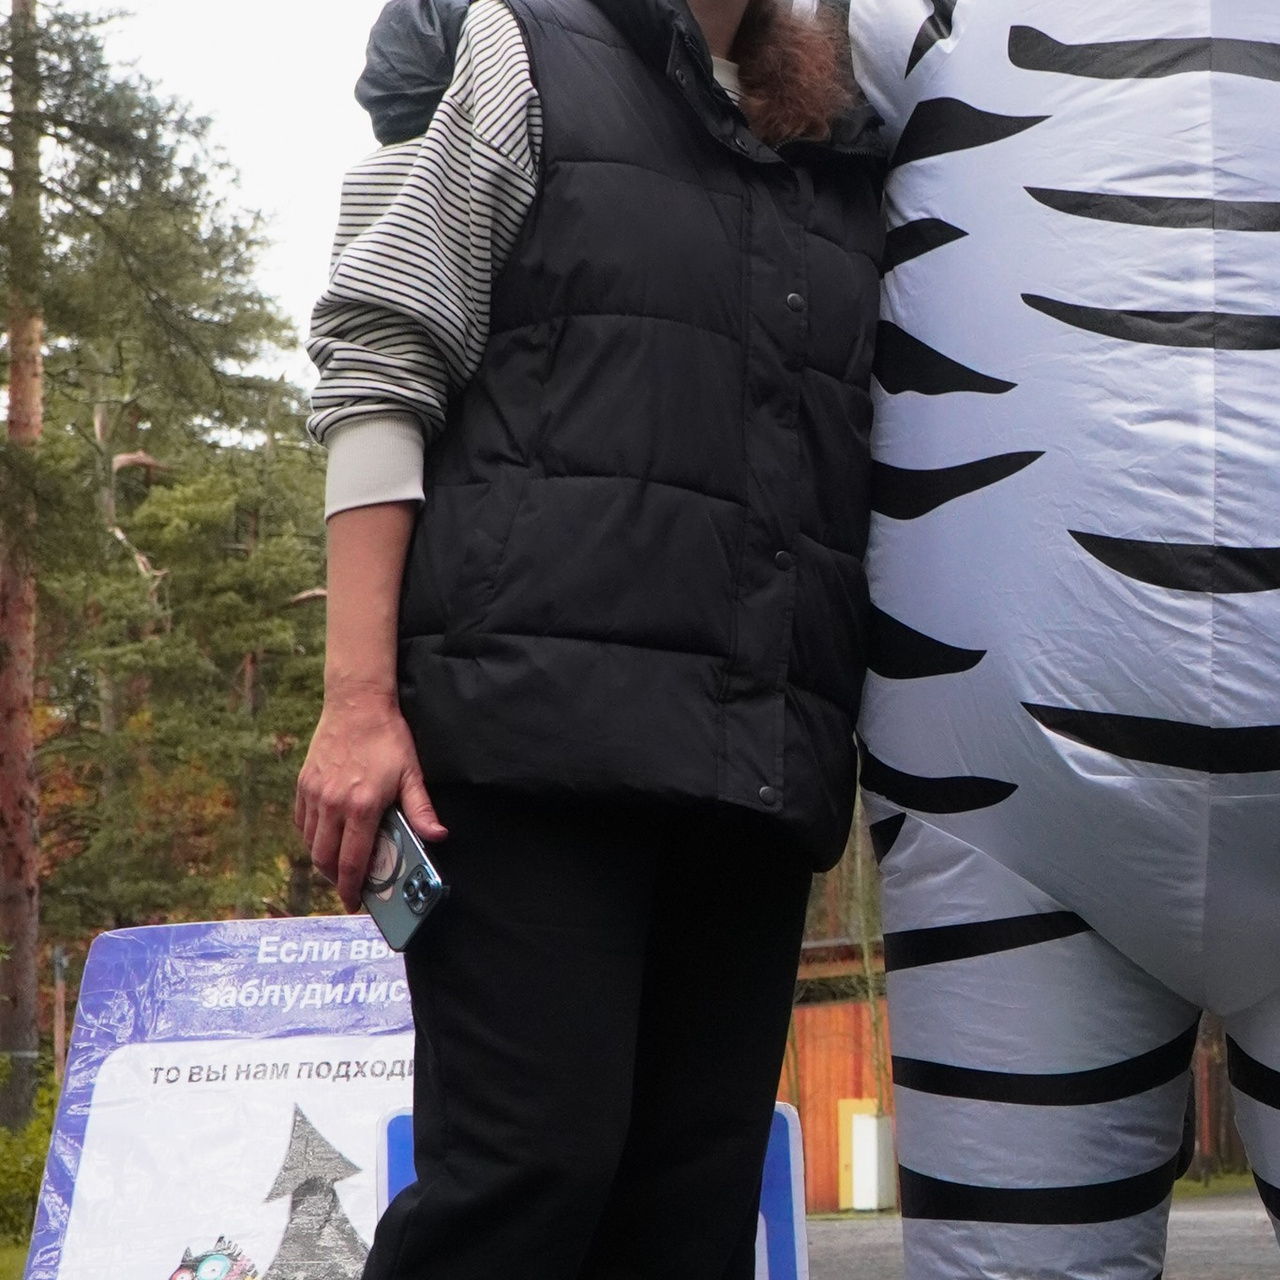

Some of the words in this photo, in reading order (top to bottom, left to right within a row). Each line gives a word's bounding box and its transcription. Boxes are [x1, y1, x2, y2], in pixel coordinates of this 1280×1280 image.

[257, 935, 341, 964] Если
[202, 978, 412, 1013] заблудилис
[151, 1064, 181, 1084] то
[188, 1064, 228, 1083] вы
[235, 1062, 290, 1081] нам
